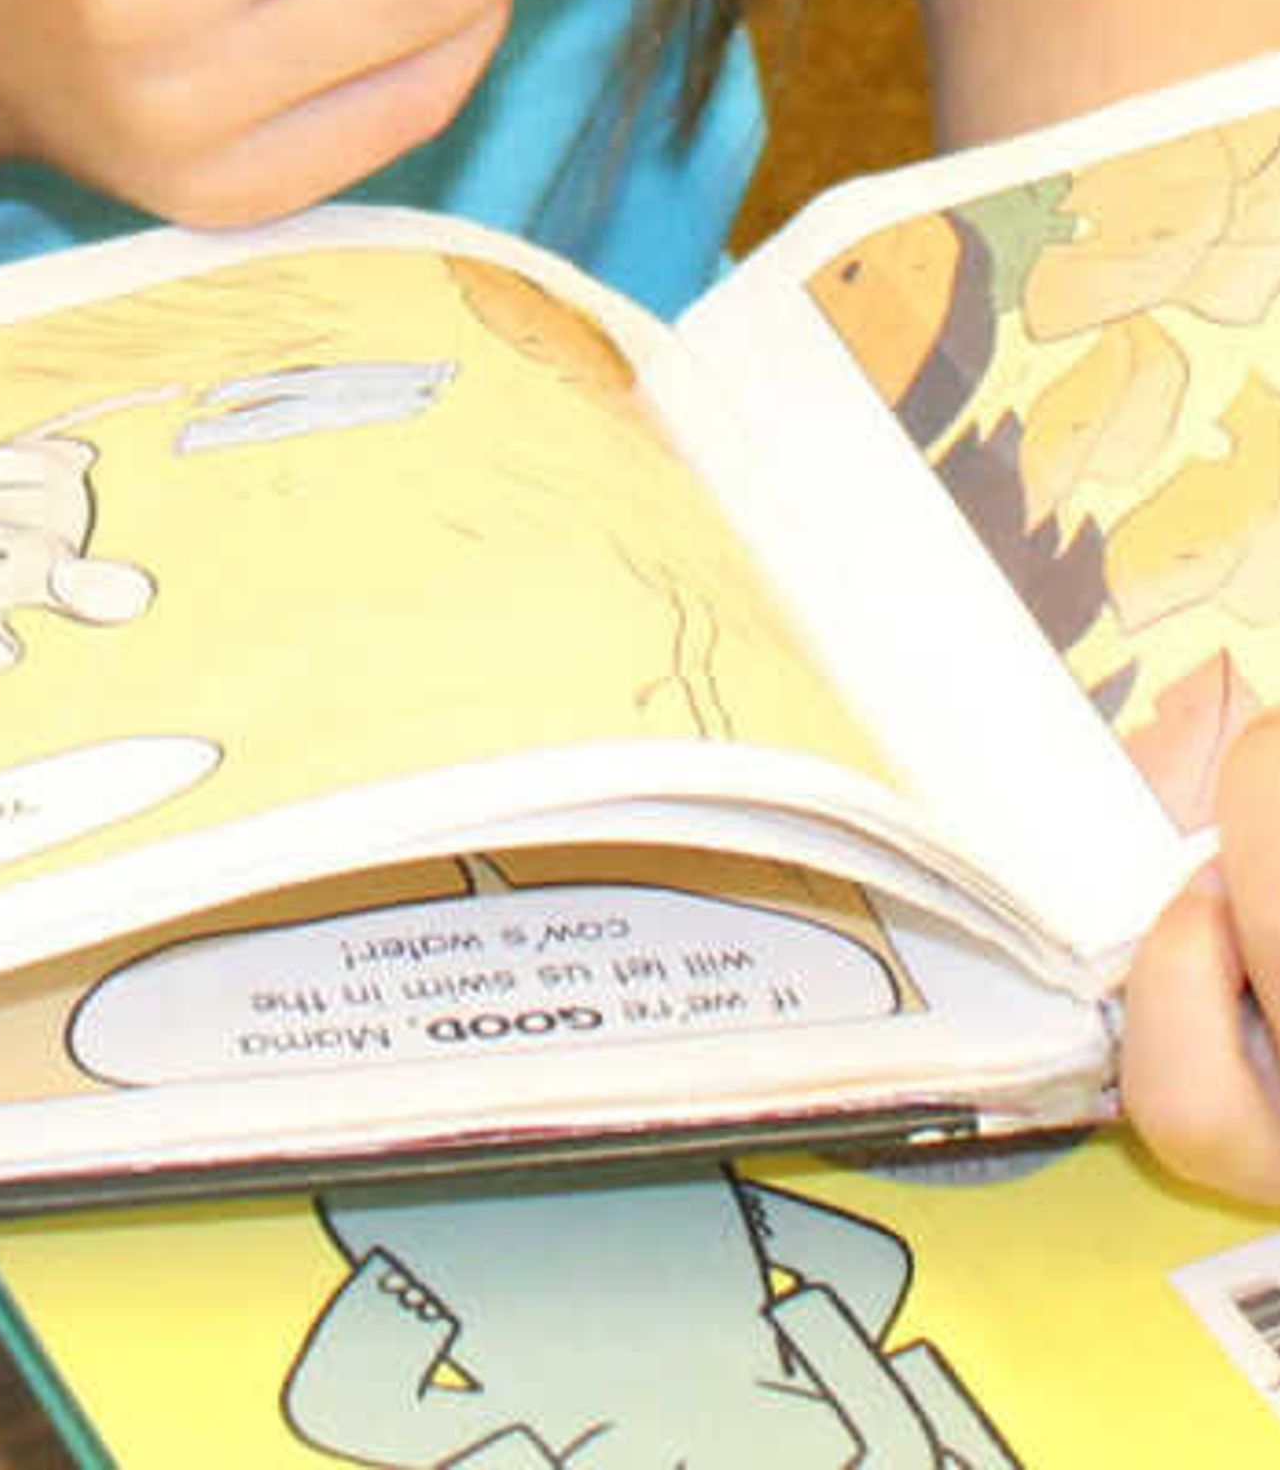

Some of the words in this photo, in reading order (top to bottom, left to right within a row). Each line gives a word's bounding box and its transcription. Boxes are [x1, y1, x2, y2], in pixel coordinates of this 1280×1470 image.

[340, 932, 484, 970] water!
[499, 915, 633, 956] cow's
[535, 965, 592, 991] us
[611, 955, 667, 988] let
[684, 947, 757, 980] will
[247, 987, 329, 1017] the
[342, 982, 384, 1010] in
[399, 969, 517, 1006] swim
[768, 986, 801, 1013] If
[619, 990, 749, 1026] we're
[237, 1023, 395, 1062] Mama
